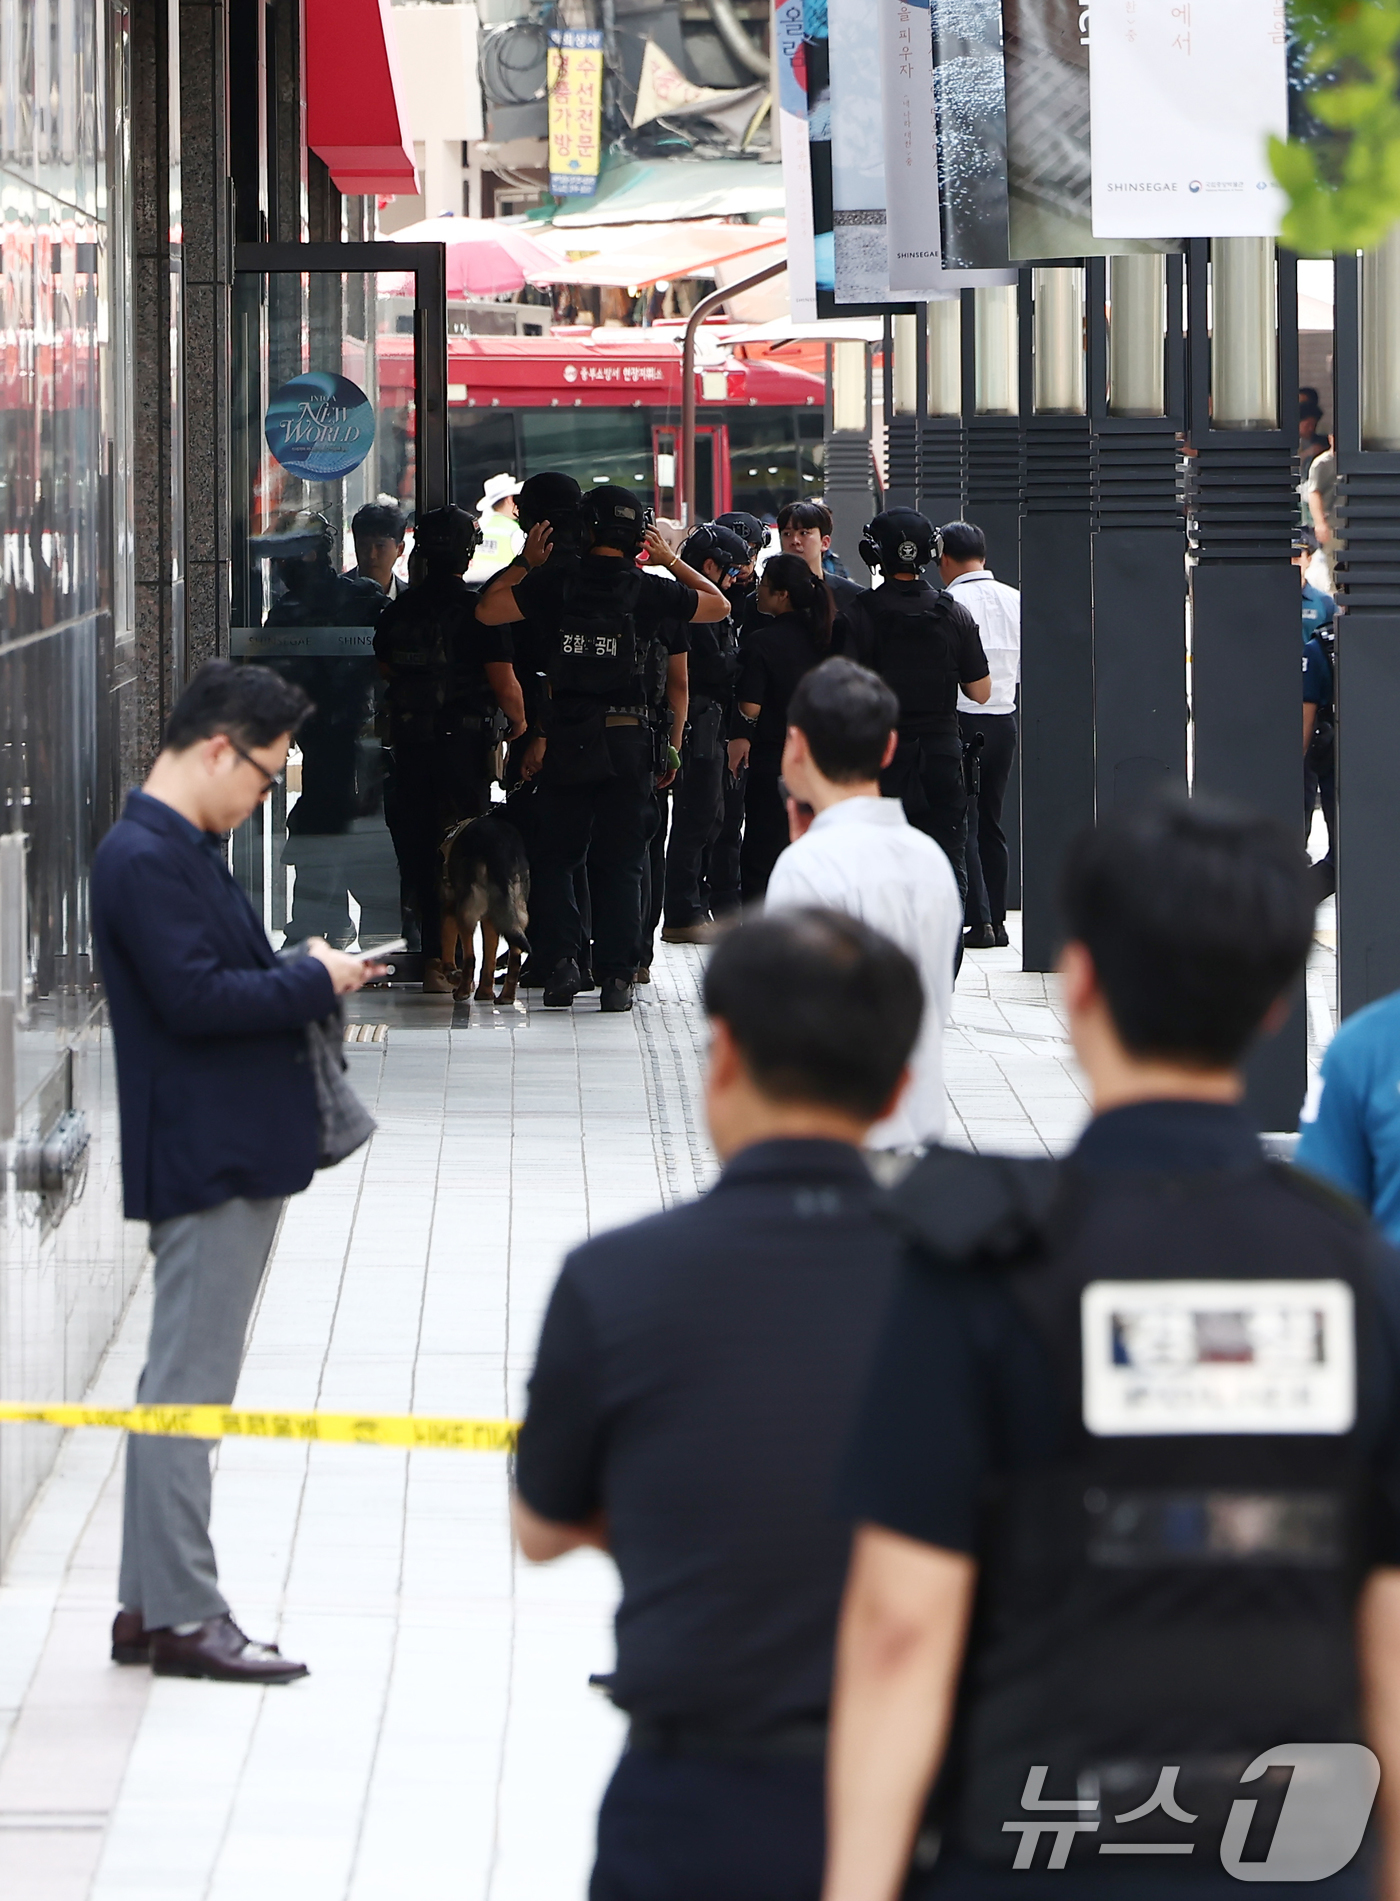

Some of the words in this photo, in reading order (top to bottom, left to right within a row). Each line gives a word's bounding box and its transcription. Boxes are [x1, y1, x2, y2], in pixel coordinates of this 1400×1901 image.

[1171, 2, 1191, 56] 에서
[1107, 182, 1178, 192] SHINSEGAE
[897, 251, 939, 259] SHINSEGAE
[580, 366, 620, 382] 중부소방서
[623, 366, 664, 382] 현장지휘소
[298, 402, 347, 427] NEW
[280, 419, 360, 443] WORLD
[563, 635, 617, 656] 경찰공대
